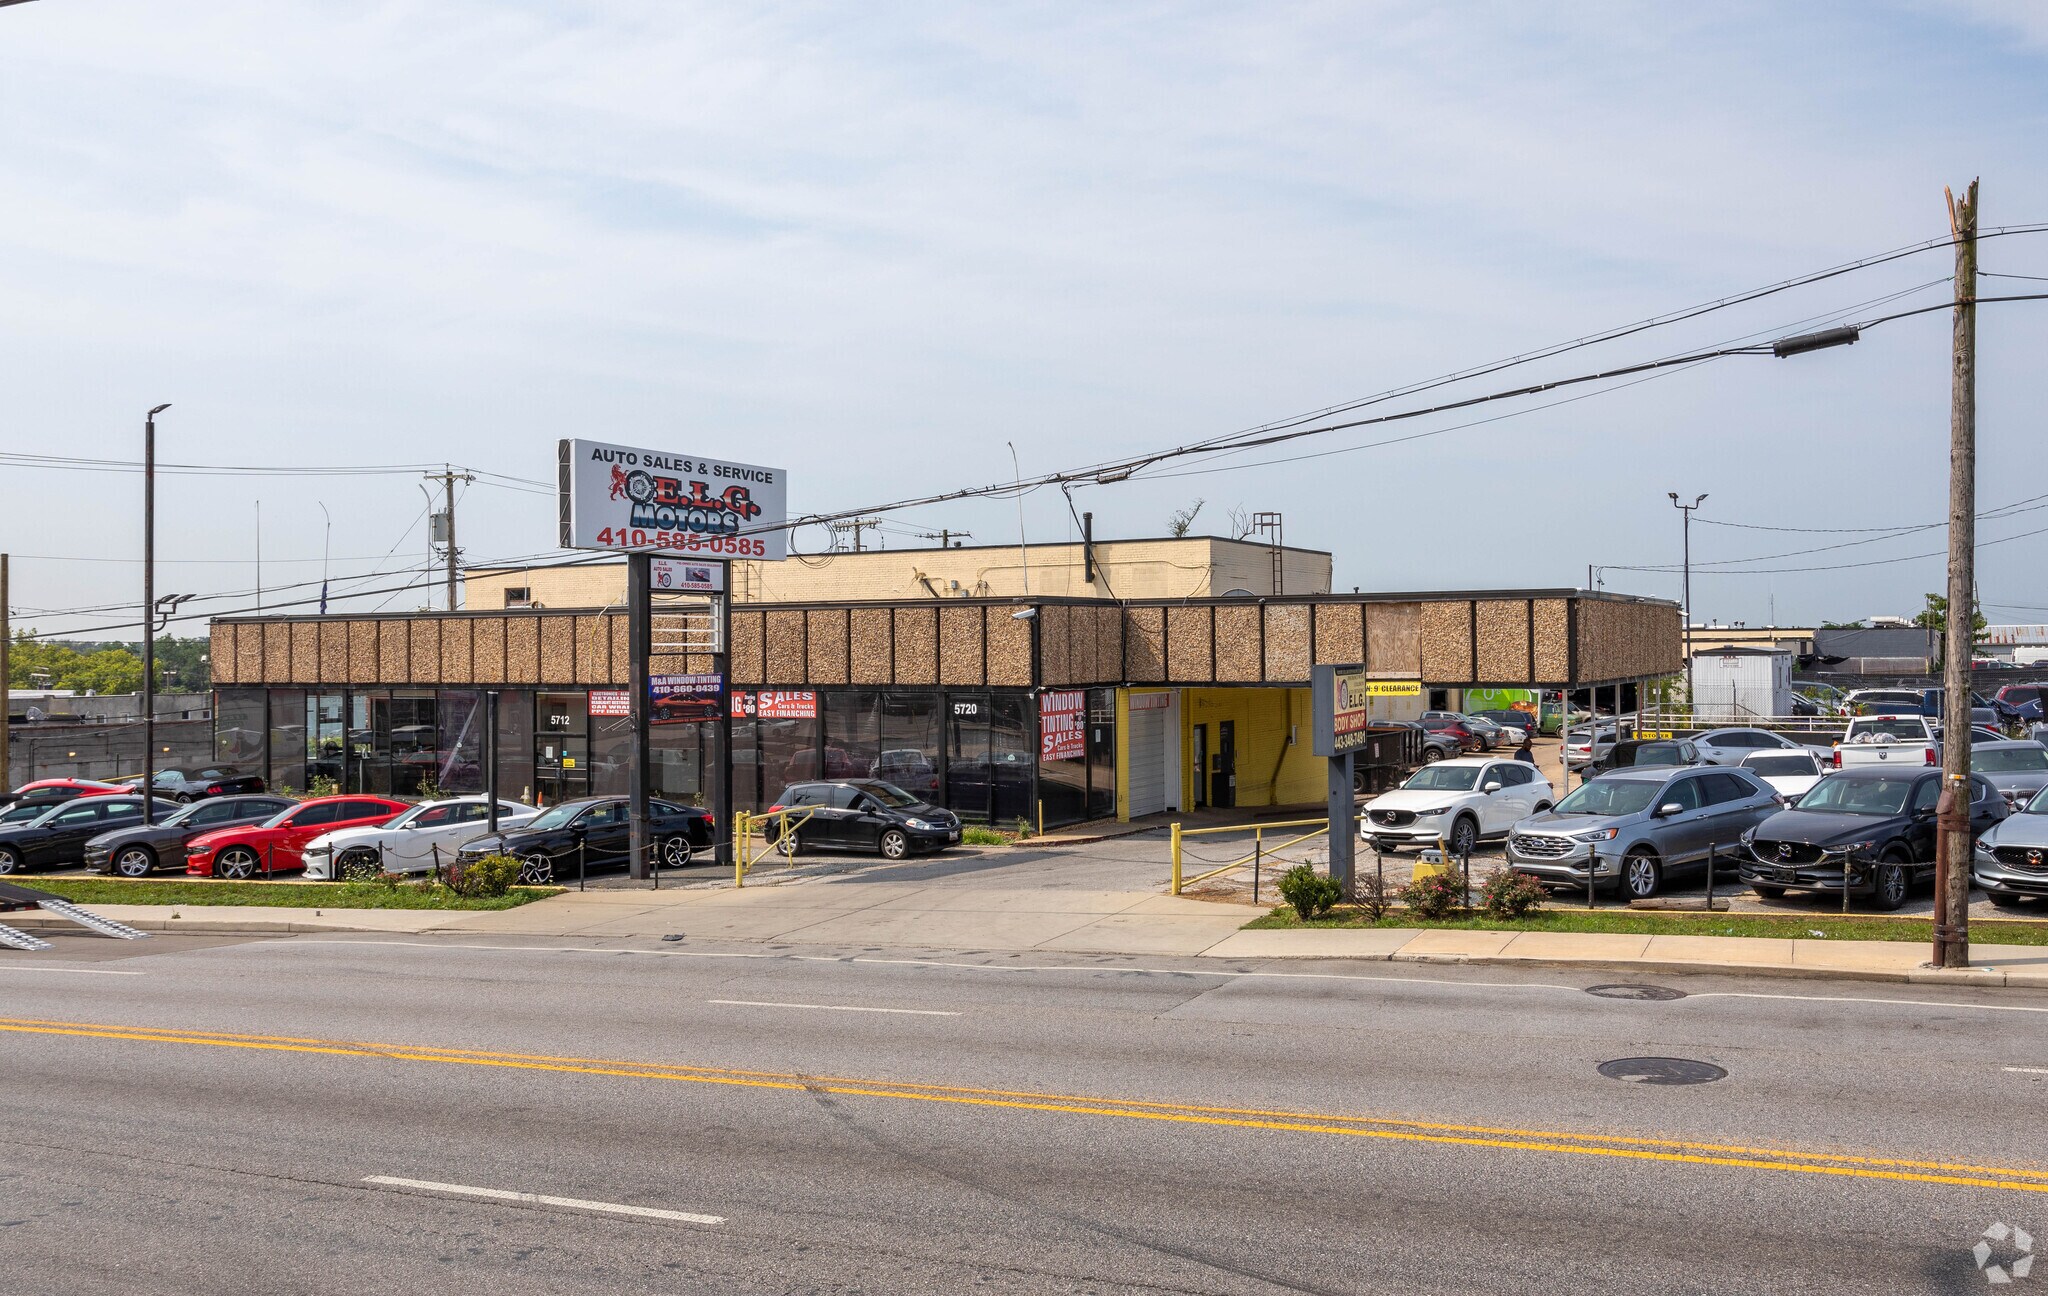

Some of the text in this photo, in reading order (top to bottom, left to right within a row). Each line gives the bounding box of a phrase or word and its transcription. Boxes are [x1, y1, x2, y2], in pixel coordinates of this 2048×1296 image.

[591, 448, 773, 484] AUTO SALES & SERVICE
[652, 475, 762, 522] E.L.G.
[630, 502, 739, 533] MOTORS
[597, 526, 765, 557] 410-585-0585
[651, 675, 721, 686] M&A WINDOW TINTING
[652, 684, 720, 694] 410-660-0439
[1381, 684, 1419, 692] CLEARANCE
[743, 704, 756, 714] $80
[760, 691, 813, 710] SALES
[954, 703, 977, 715] 5720
[1042, 692, 1083, 713] WINDOW
[550, 715, 570, 725] 5712
[759, 709, 775, 717] EASY
[1334, 712, 1365, 732] BODY SHOP
[1042, 713, 1074, 733] TINTING
[1043, 731, 1083, 754] SALES
[1043, 753, 1055, 762] EASY
